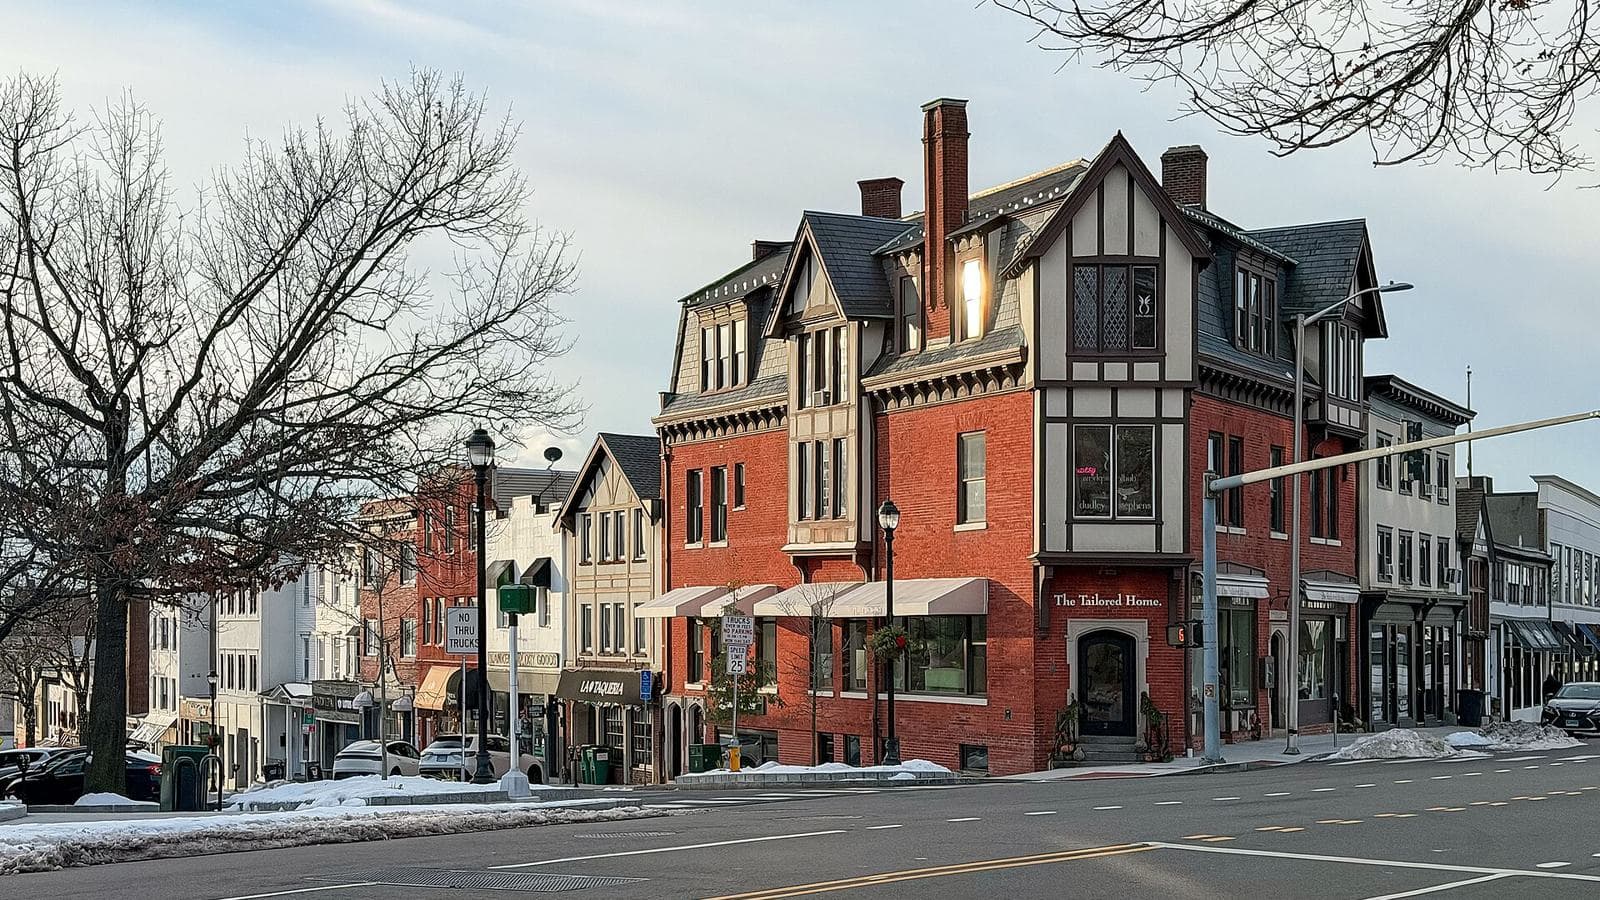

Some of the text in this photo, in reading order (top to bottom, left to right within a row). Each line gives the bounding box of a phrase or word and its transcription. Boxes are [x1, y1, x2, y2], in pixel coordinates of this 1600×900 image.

[1079, 500, 1105, 512] dudley
[1054, 593, 1162, 607] The Tailored Home.
[458, 613, 470, 622] NO
[454, 625, 475, 635] THRU
[449, 638, 479, 649] TRUCKS
[731, 660, 743, 673] 25
[580, 680, 624, 696] LA TAQUERIA
